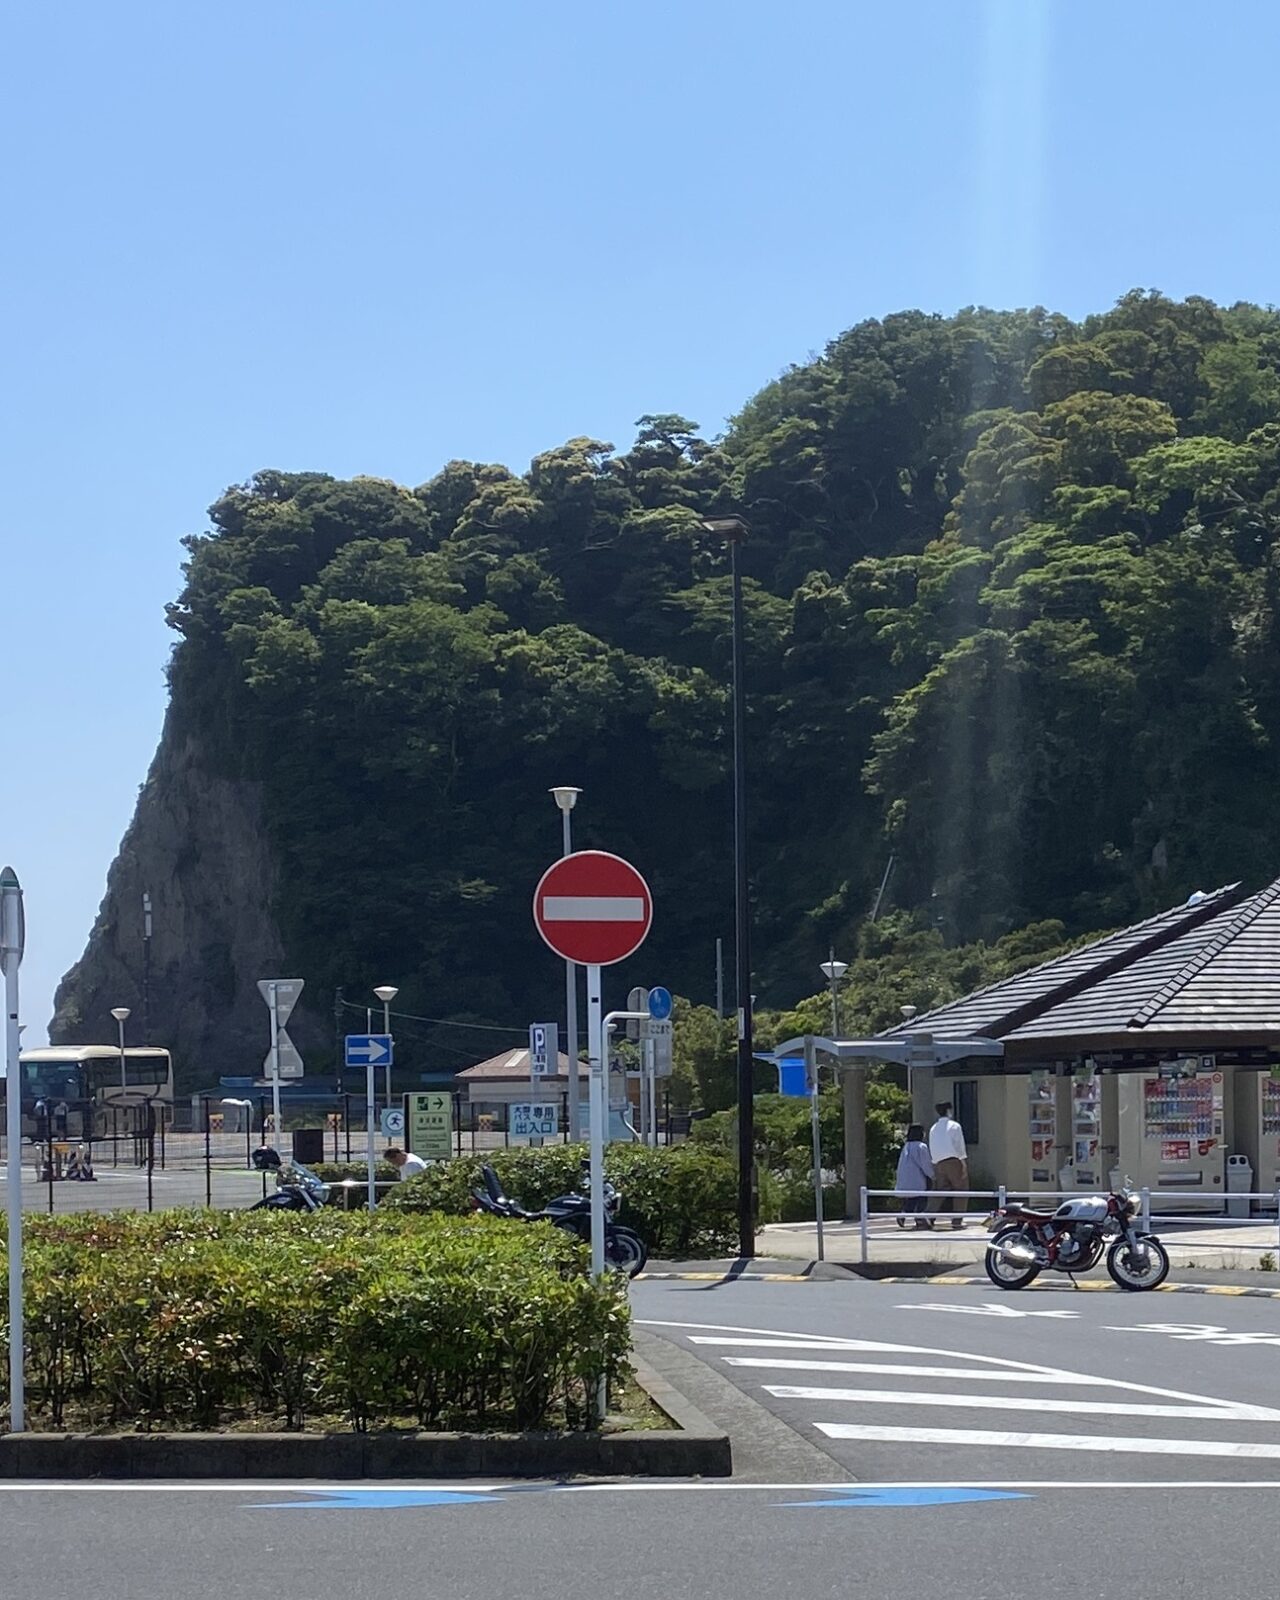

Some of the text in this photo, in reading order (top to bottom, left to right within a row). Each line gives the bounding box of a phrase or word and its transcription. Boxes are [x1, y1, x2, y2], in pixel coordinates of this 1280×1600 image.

[534, 1028, 545, 1054] P
[533, 1106, 554, 1119] 専用
[515, 1122, 552, 1134] 出入口
